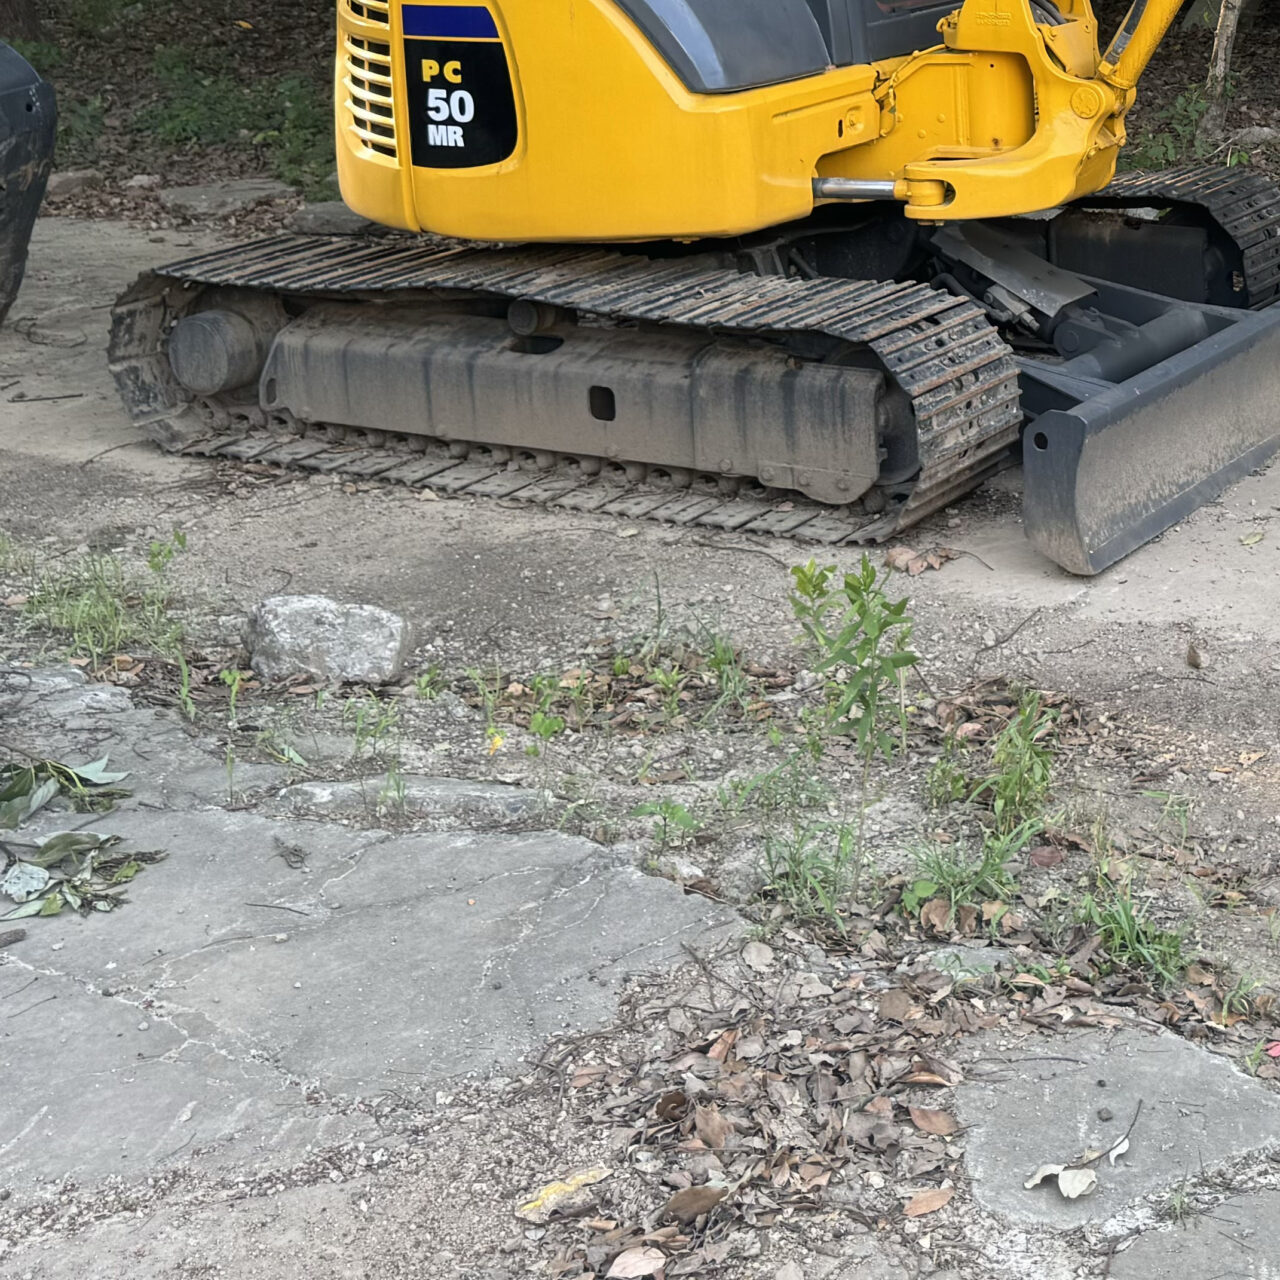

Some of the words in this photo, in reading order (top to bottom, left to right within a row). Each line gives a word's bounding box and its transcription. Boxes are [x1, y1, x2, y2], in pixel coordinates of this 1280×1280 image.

[421, 59, 462, 83] PC
[427, 88, 475, 123] 50
[427, 124, 465, 147] MR
